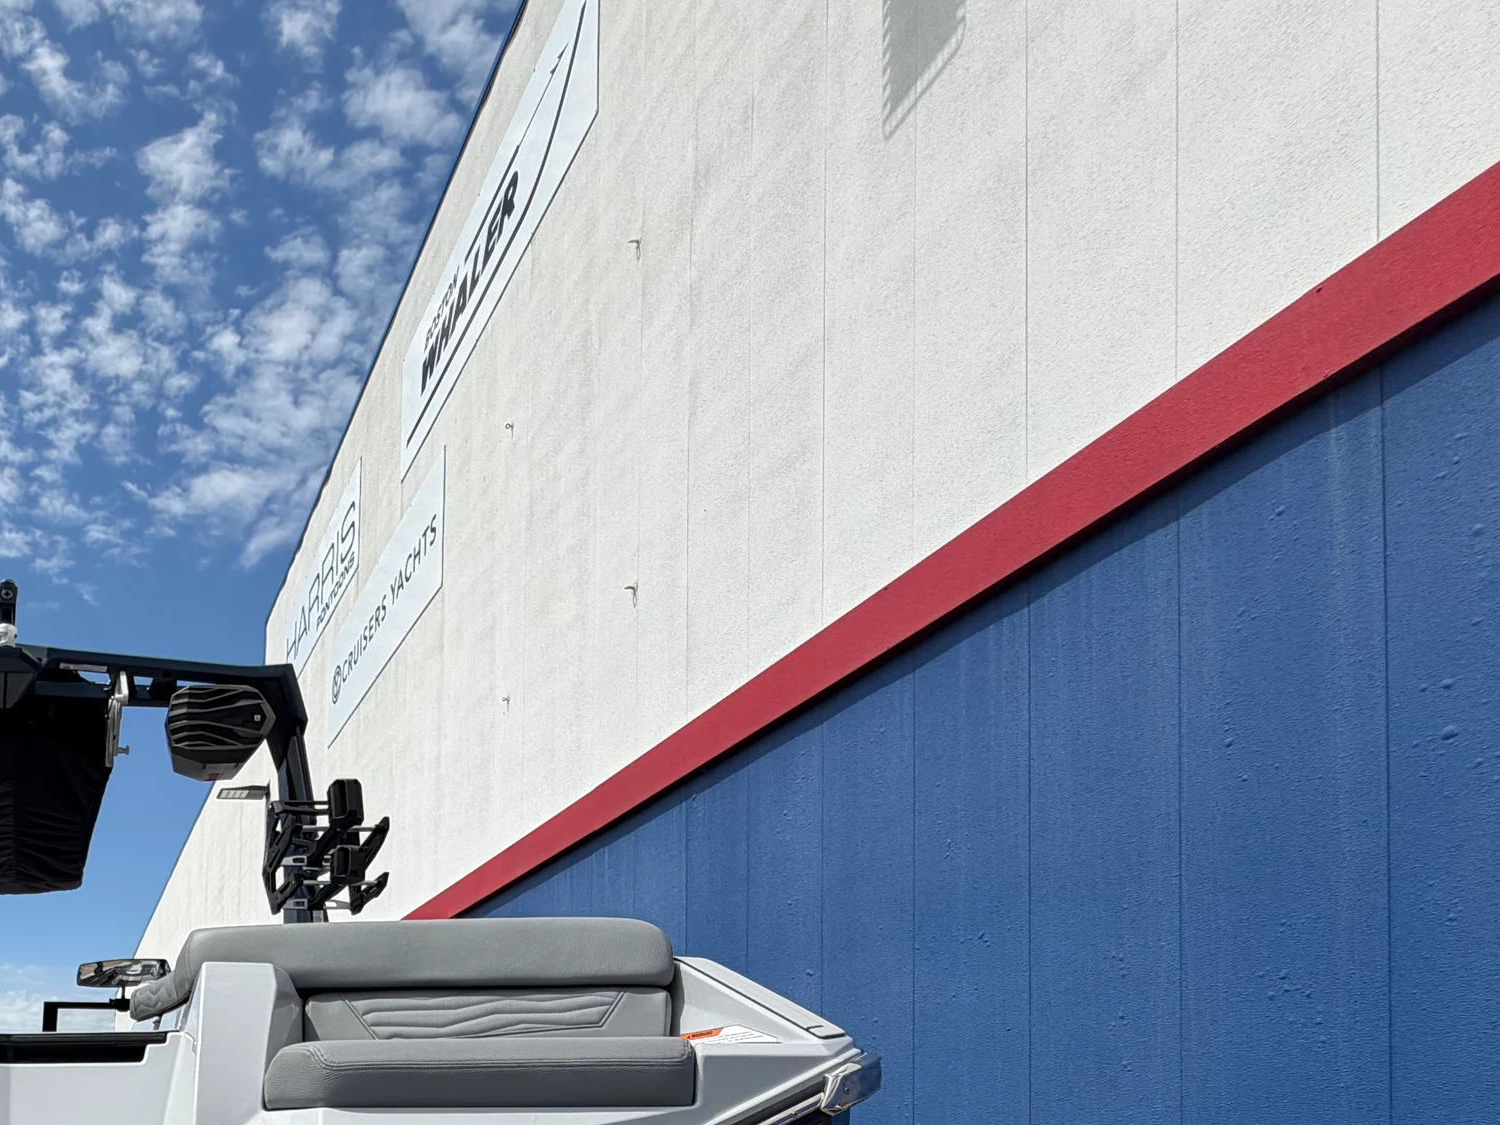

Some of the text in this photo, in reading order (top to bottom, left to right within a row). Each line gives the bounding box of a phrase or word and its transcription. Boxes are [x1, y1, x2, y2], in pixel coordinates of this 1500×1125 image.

[420, 170, 519, 397] WHALER
[424, 265, 460, 353] BOSTON
[286, 500, 356, 665] HARRIS
[316, 551, 355, 632] PONTOONS
[342, 514, 437, 684] CRUISERS YACHTS
